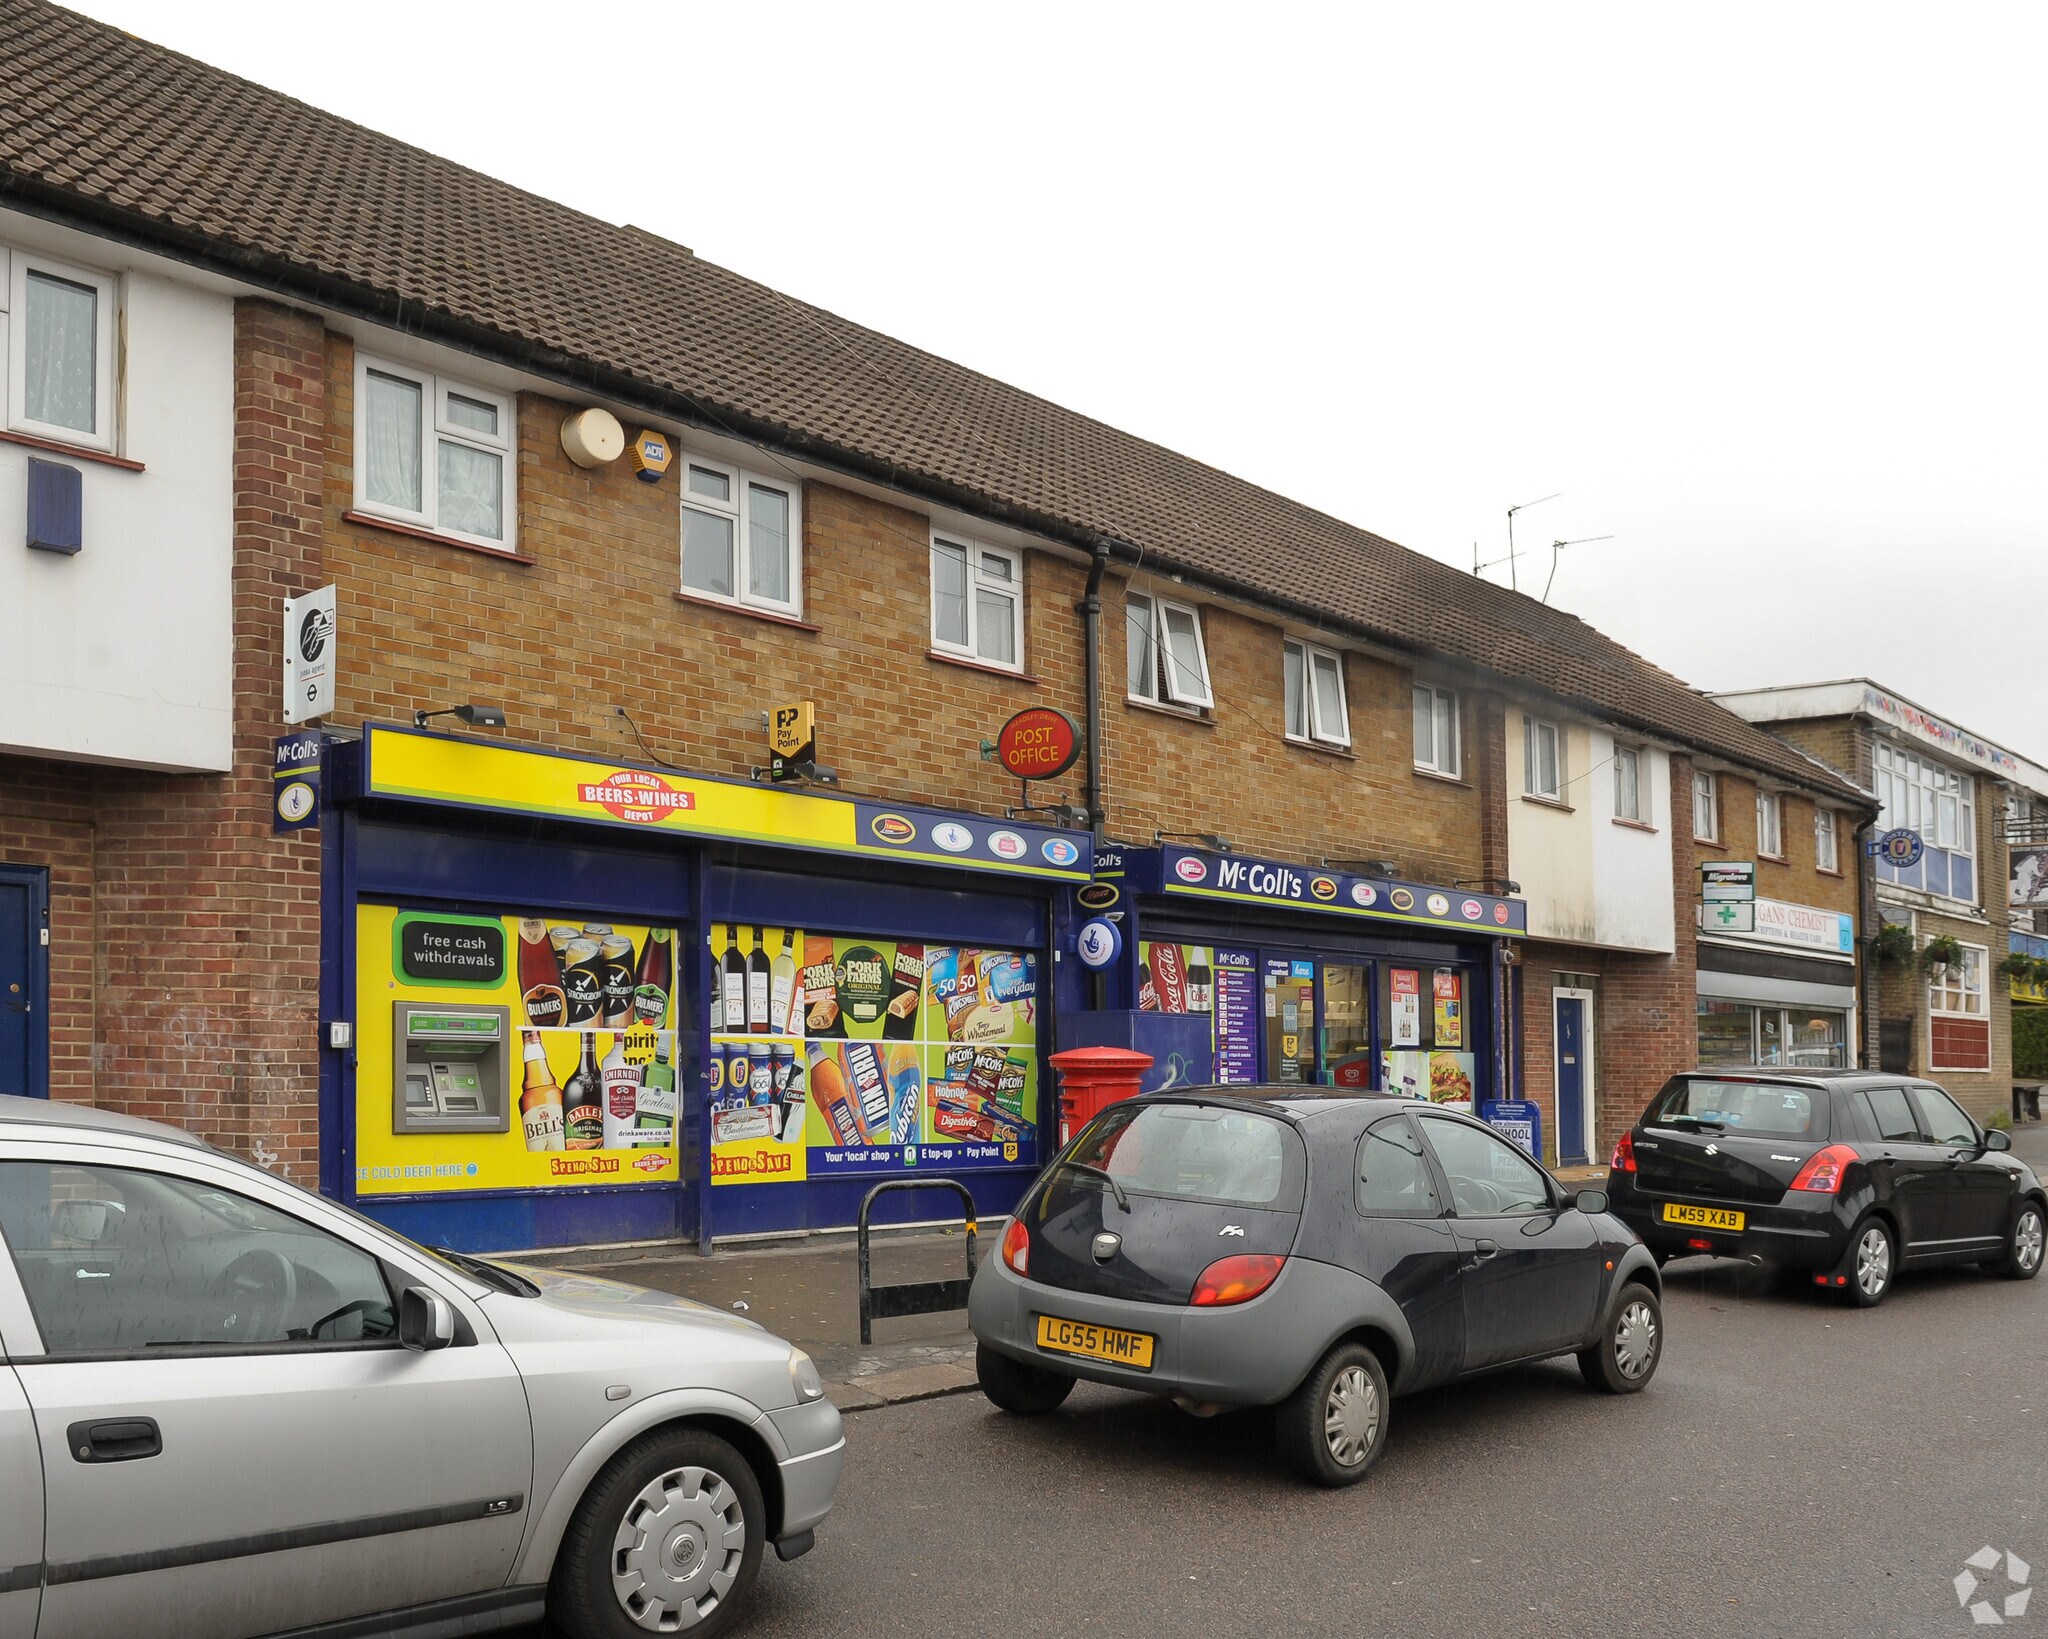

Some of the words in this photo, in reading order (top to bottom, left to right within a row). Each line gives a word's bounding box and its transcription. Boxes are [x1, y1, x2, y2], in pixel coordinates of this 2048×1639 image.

[644, 445, 664, 458] ADT
[1011, 713, 1038, 729] HEADLEY
[778, 729, 792, 739] Pay
[778, 736, 800, 749] Point
[1015, 726, 1053, 746] POST
[277, 741, 319, 764] McColl's
[1008, 745, 1060, 766] OFFICE
[608, 773, 632, 787] YOUR
[634, 773, 661, 790] LOCAL
[624, 809, 654, 821] DEPOT
[1217, 859, 1302, 898] McColl's
[1759, 904, 1785, 925] GANS
[1788, 908, 1827, 932] CHEMIST
[423, 932, 450, 947] free
[456, 936, 486, 950] cash
[1784, 929, 1788, 938] &
[414, 950, 495, 967] withdrawals
[846, 960, 882, 974] PORK
[896, 952, 924, 968] PORK
[925, 949, 951, 970] KINGSMILL
[980, 954, 1009, 980] KINGSMILL
[1219, 953, 1250, 966] McColl's
[846, 971, 882, 985] FARMS
[894, 962, 923, 979] FARMS
[1294, 963, 1310, 976] here
[804, 975, 836, 991] ARMS
[847, 982, 882, 991] ORIGINAL
[940, 978, 956, 996] 50
[959, 974, 976, 993] 50
[998, 981, 1036, 998] everyday
[1191, 989, 1208, 1002] Coke
[527, 998, 562, 1017] BULMERS
[635, 995, 664, 1014] BULMERS
[948, 994, 977, 1021] KINGSMILL
[966, 1024, 1006, 1041] Wholemeal
[624, 1033, 659, 1051] pirit
[638, 1091, 676, 1112] Gordon's
[525, 1116, 565, 1141] BELL'S
[720, 1124, 766, 1136] Budweiser
[940, 1115, 978, 1128] Digestives
[618, 1129, 671, 1137] drinkaware.co.uk
[825, 1151, 844, 1163] Your
[870, 1150, 890, 1163] shop
[921, 1148, 927, 1158] E
[928, 1148, 953, 1161] top-up
[966, 1147, 980, 1159] Pay
[981, 1146, 999, 1157] Point
[372, 1166, 401, 1180] COLD
[404, 1165, 432, 1178] BEER
[435, 1164, 463, 1177] HERE
[1669, 1205, 1705, 1222] LM59
[1709, 1210, 1738, 1227] XAB
[1046, 1320, 1098, 1350] LG55
[1102, 1331, 1143, 1358] HMF
[489, 1500, 508, 1512] LS
